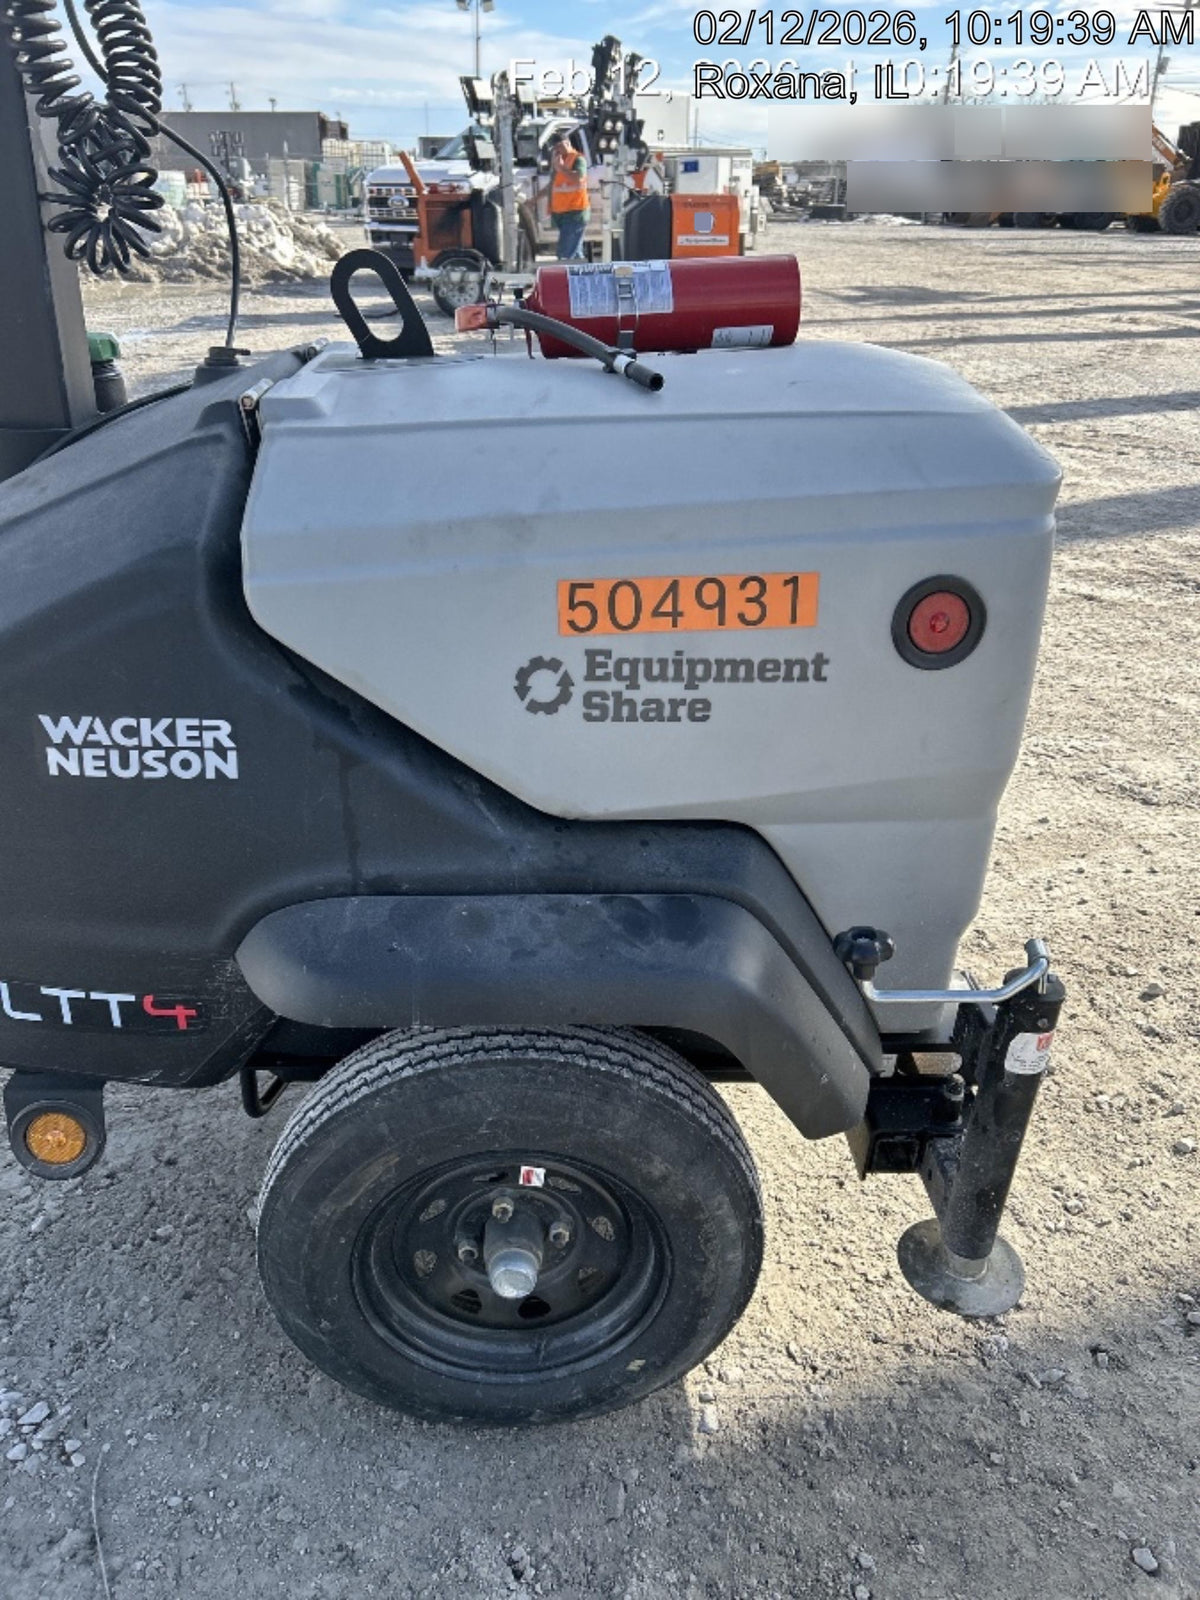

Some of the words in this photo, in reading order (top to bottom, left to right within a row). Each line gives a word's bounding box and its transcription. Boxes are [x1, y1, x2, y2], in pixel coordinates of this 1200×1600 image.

[565, 574, 801, 634] 504931
[583, 648, 830, 691] Equipment
[582, 690, 712, 723] Share
[38, 713, 237, 749] WACKER
[46, 746, 240, 780] NEUSON
[0, 980, 198, 1031] LTT4
